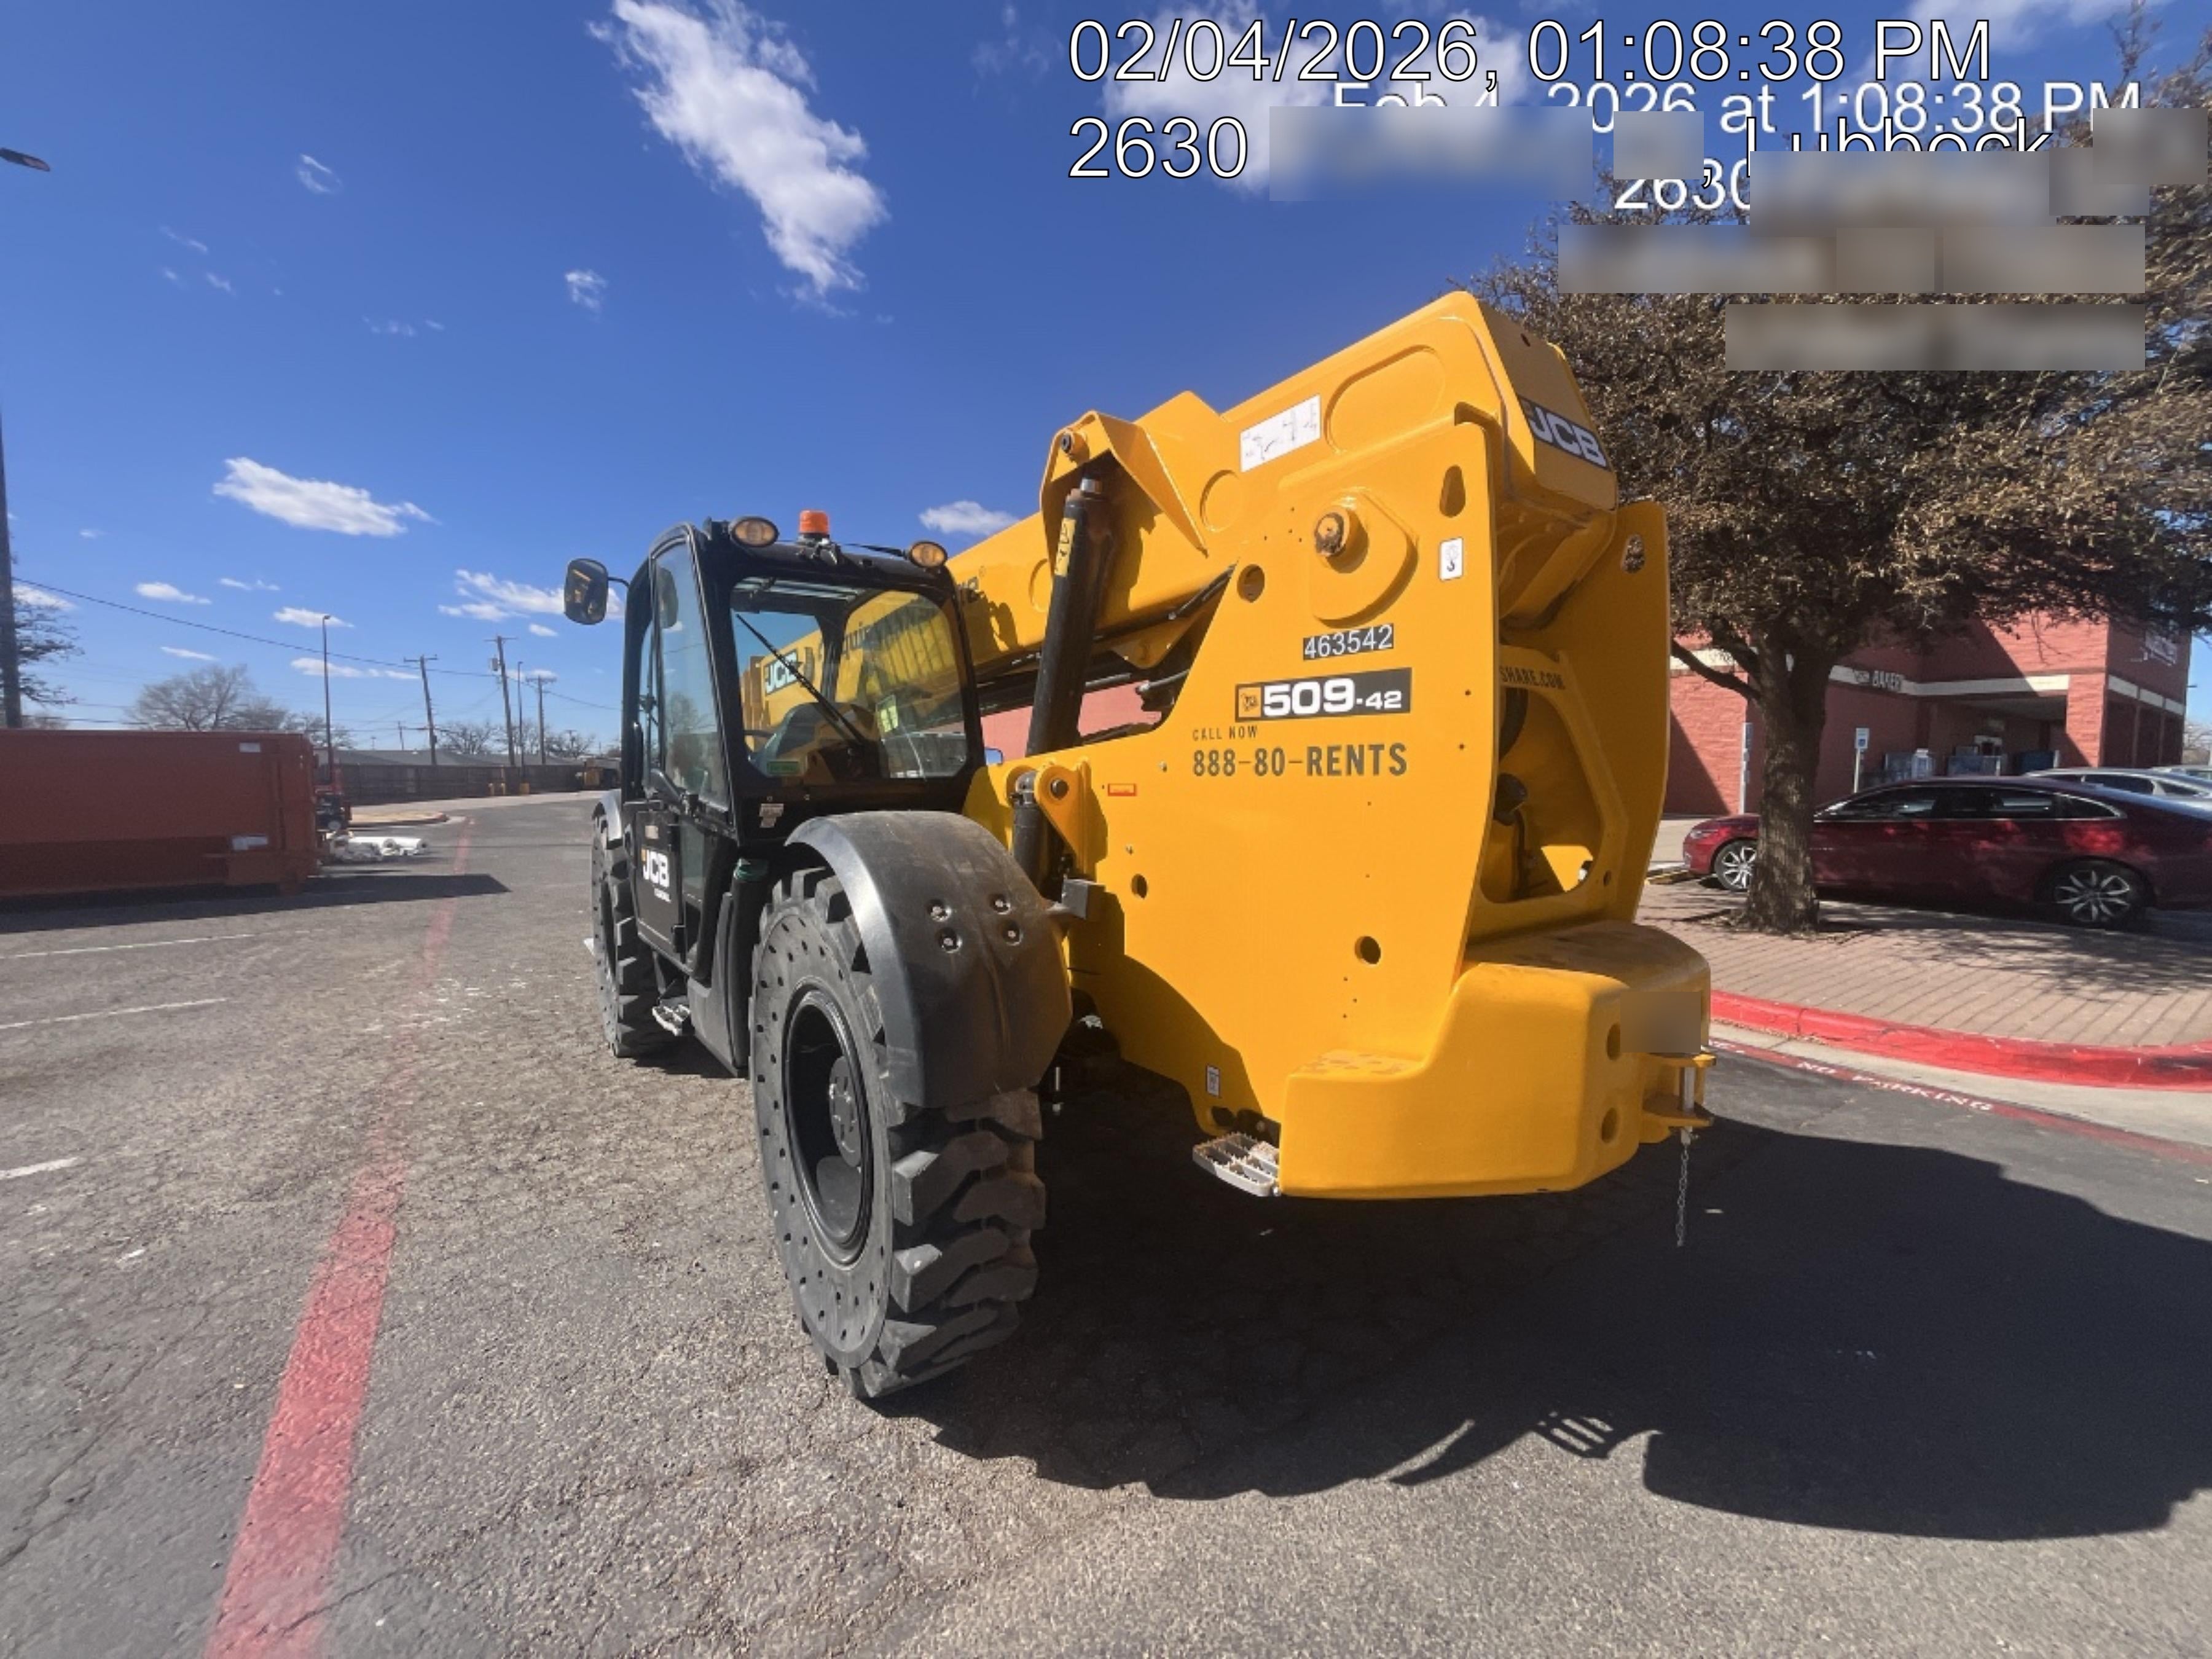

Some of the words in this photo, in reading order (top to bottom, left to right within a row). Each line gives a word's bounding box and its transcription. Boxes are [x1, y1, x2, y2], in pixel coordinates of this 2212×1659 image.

[1529, 406, 1606, 467] JCB
[1304, 625, 1394, 659] 463542
[1193, 727, 1222, 740] CALL
[1230, 726, 1258, 739] NOW
[1193, 743, 1407, 777] 888-80-RENTS
[643, 849, 670, 887] JCB
[1852, 1076, 1992, 1110] PARKING
